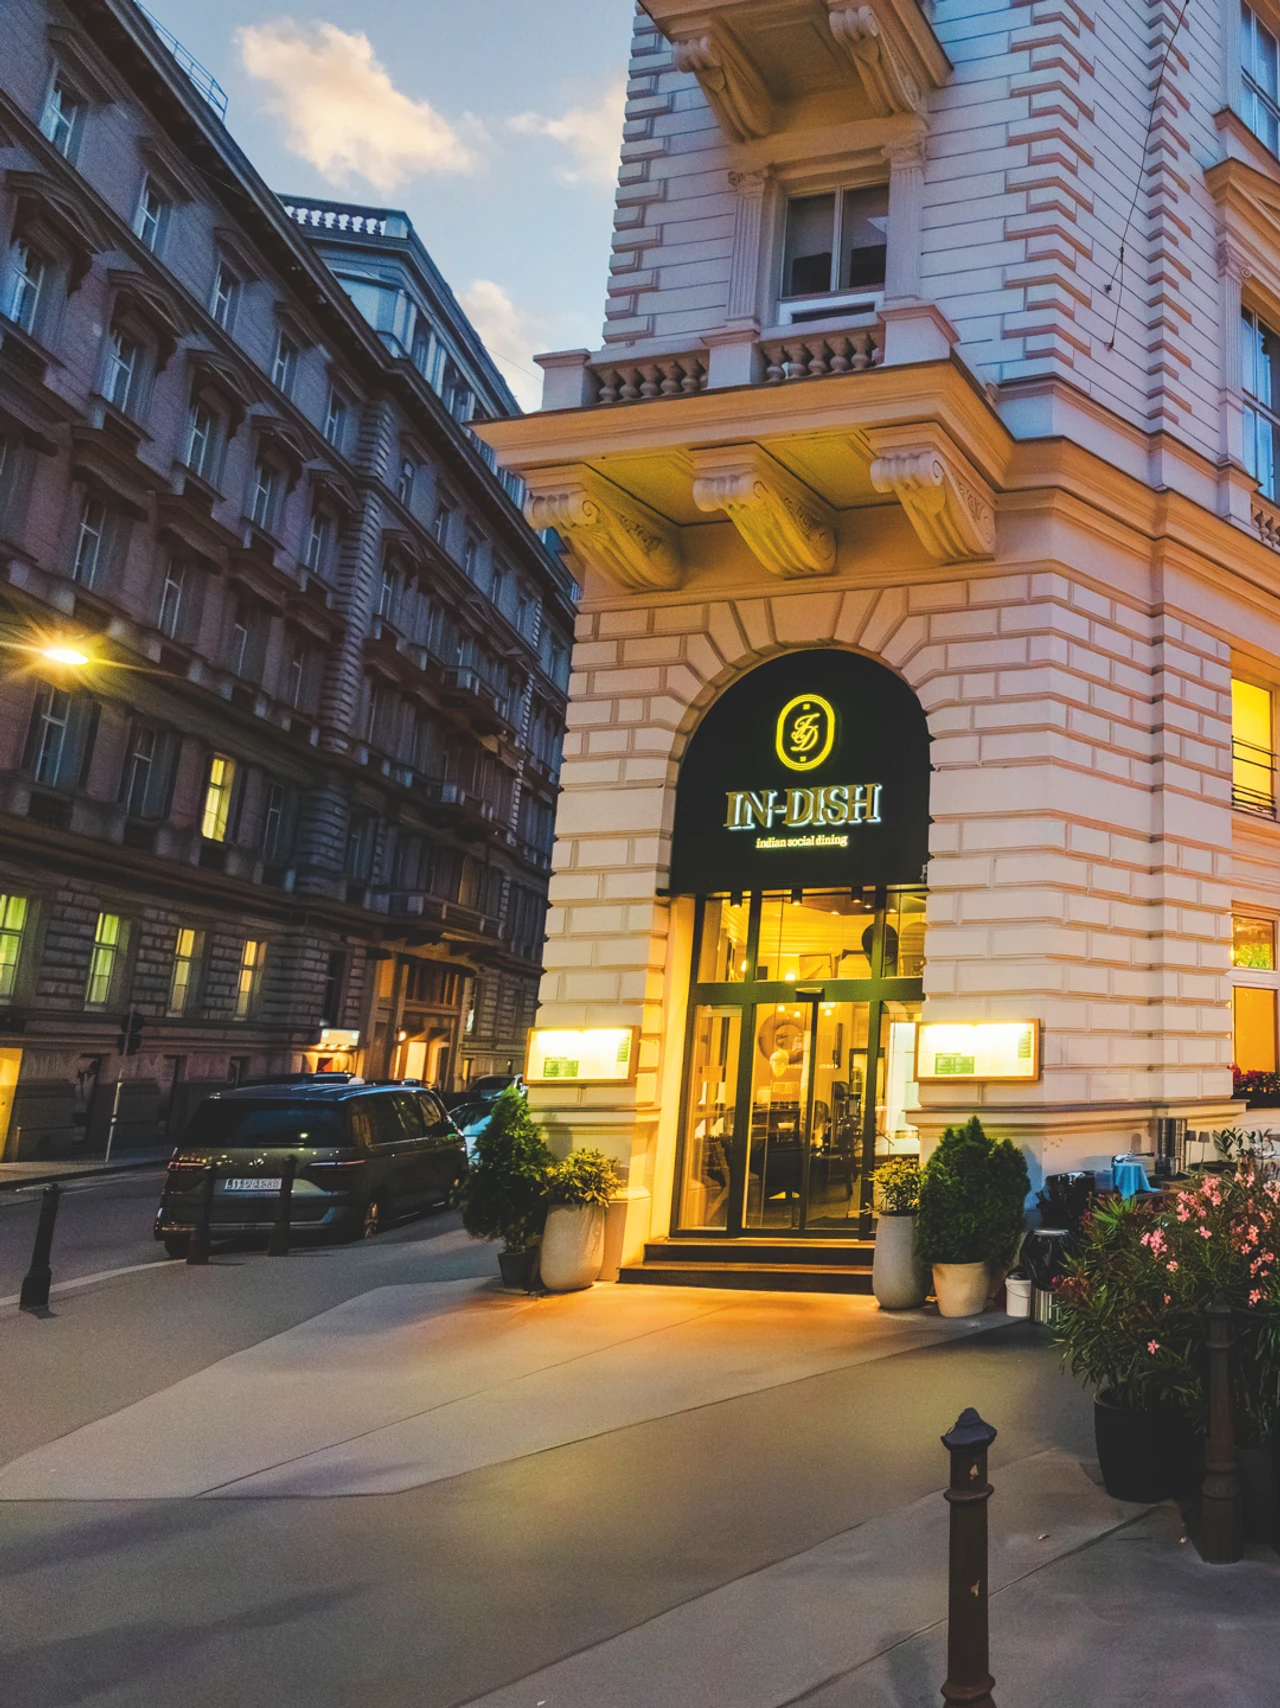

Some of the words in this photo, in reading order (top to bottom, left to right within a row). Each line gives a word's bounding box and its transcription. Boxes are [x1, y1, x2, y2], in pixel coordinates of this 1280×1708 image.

[723, 783, 882, 830] IN-DISH
[756, 837, 787, 849] indian
[787, 835, 815, 848] social
[815, 834, 848, 847] dining
